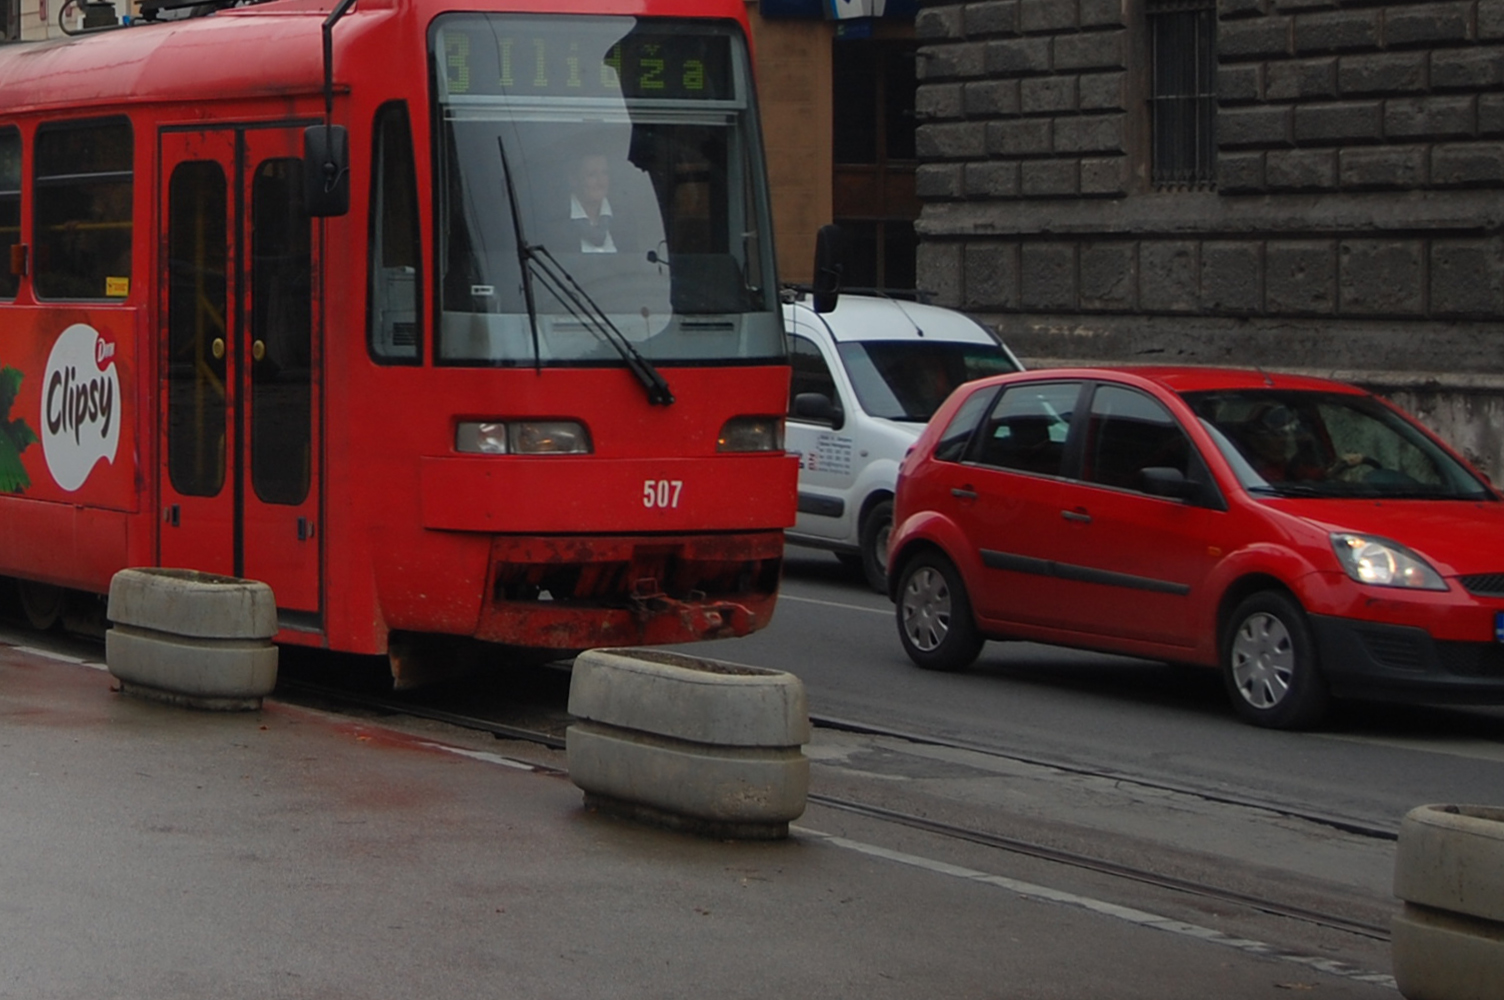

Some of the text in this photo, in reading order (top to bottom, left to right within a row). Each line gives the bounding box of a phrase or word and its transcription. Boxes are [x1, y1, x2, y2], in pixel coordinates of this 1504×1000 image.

[446, 33, 470, 93] 3
[46, 365, 113, 447] Clipsy
[643, 480, 683, 508] 507
